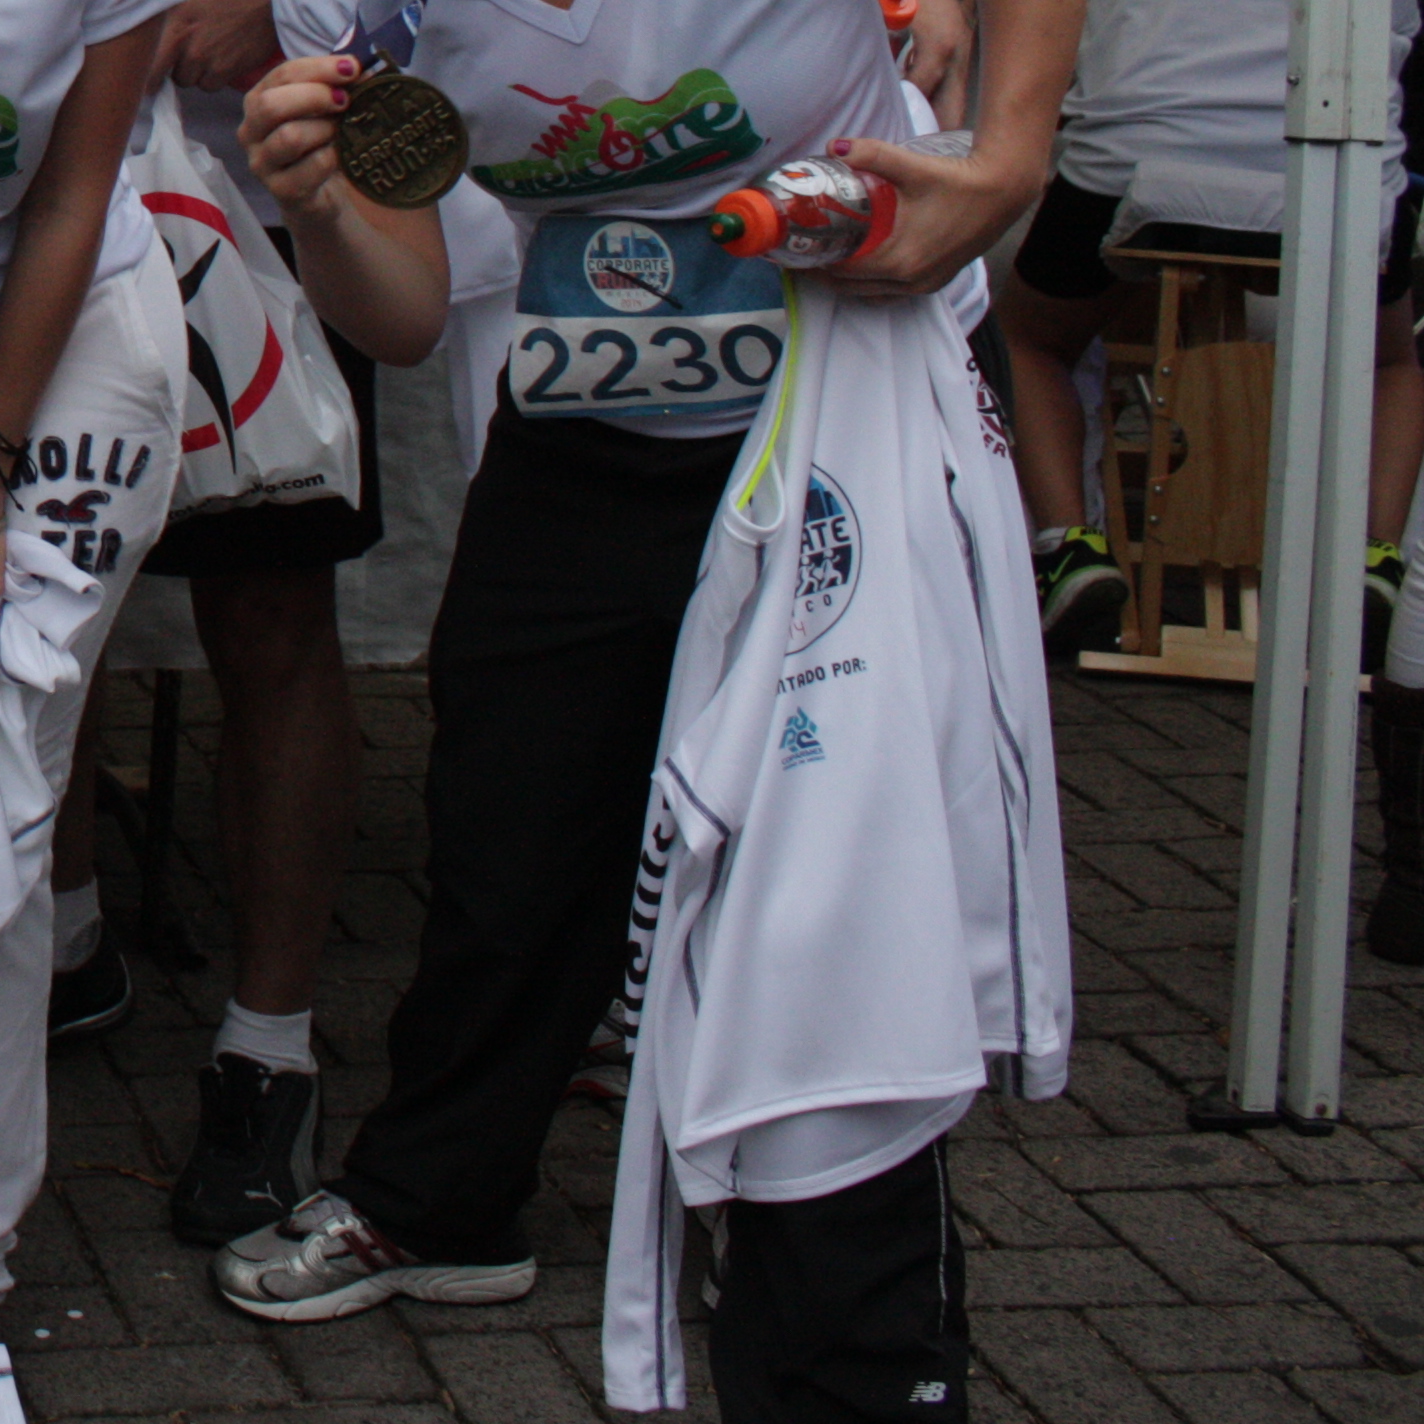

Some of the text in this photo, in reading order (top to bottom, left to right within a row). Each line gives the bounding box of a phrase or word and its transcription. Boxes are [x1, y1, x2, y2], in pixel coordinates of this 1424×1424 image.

[349, 100, 451, 178] CORPORATE
[368, 145, 430, 195] RUN
[587, 259, 669, 272] CORPORATE
[520, 324, 784, 403] 2230
[832, 657, 866, 680] POR:
